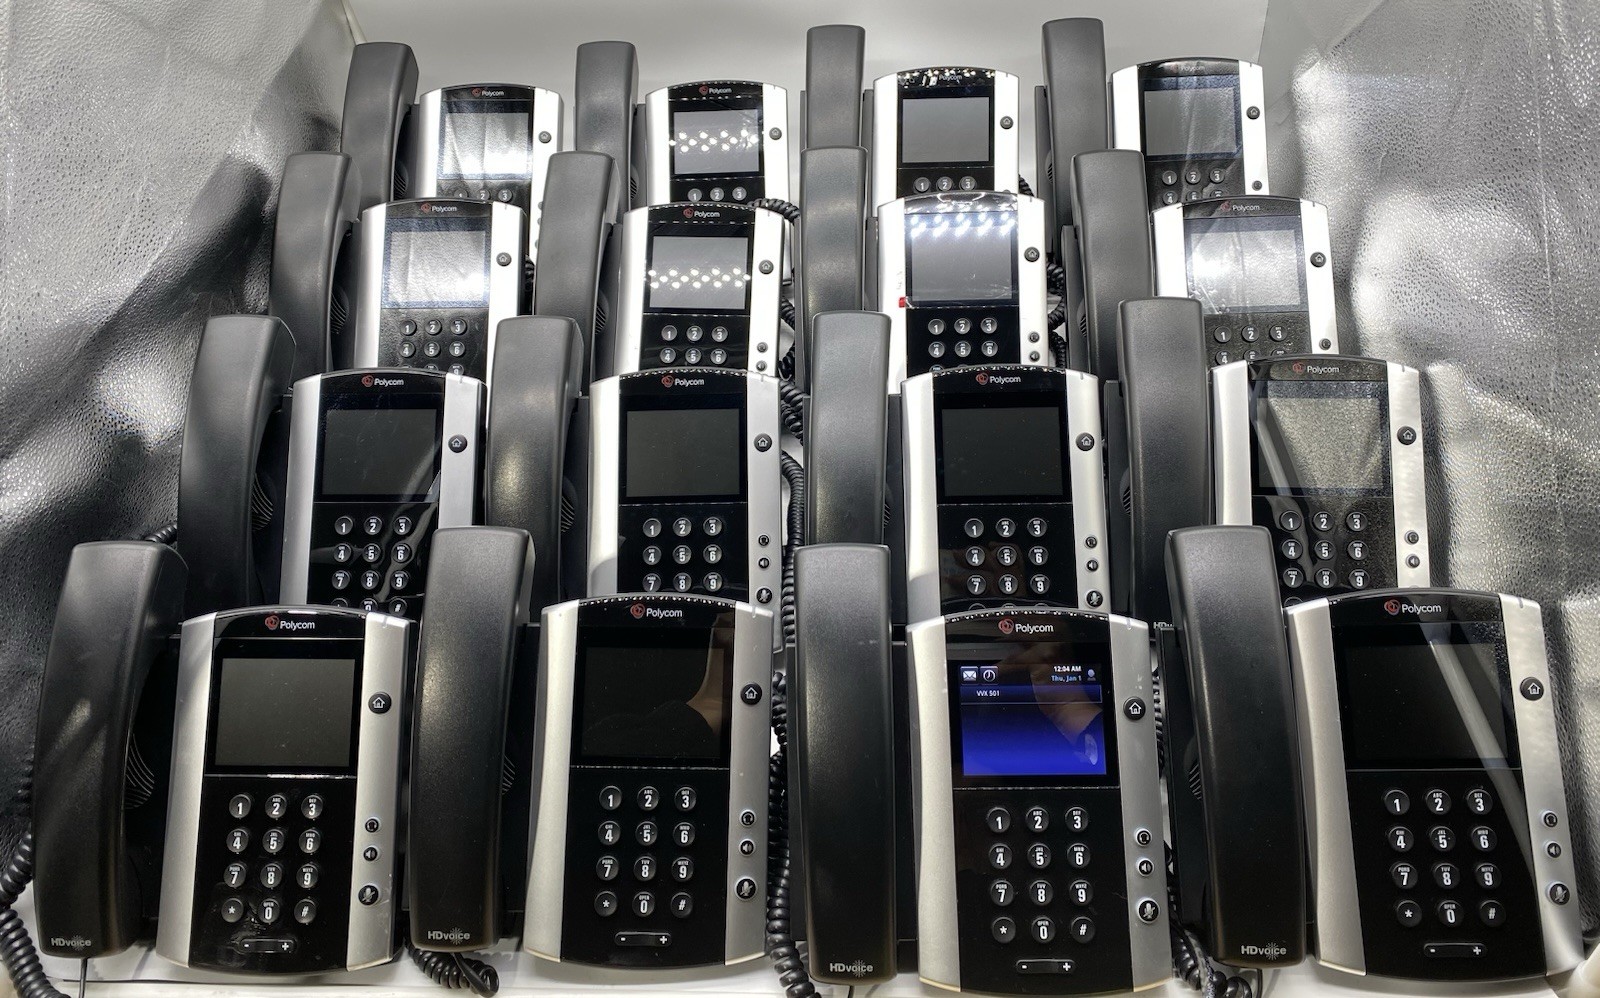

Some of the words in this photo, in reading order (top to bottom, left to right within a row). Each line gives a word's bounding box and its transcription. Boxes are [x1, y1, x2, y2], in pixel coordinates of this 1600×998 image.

[1232, 204, 1260, 212] Polycom
[694, 210, 720, 218] Polycom
[430, 324, 436, 332] 2
[455, 324, 460, 332] 3
[960, 324, 965, 332] 2
[986, 323, 992, 331] 3
[692, 330, 697, 339] 2
[717, 332, 722, 340] 3
[1248, 331, 1254, 340] 2
[1276, 330, 1282, 339] 3
[403, 347, 409, 355] 4
[429, 346, 434, 354] 5
[454, 346, 460, 354] 6
[933, 348, 940, 356] 4
[960, 347, 966, 355] 5
[987, 346, 993, 354] 6
[664, 354, 670, 362] 4
[691, 354, 696, 362] 5
[716, 354, 721, 362] 6
[1222, 355, 1228, 364] 4
[1307, 365, 1340, 374] Polycom
[374, 378, 404, 387] Polycom
[675, 378, 704, 387] Polycom
[990, 376, 1021, 384] Polycom
[370, 523, 376, 532] 2
[399, 523, 405, 532] 3
[1321, 518, 1327, 528] 2
[1354, 519, 1360, 529] 3
[679, 524, 686, 534] 2
[710, 524, 716, 533] 3
[1003, 525, 1009, 535] 2
[1034, 525, 1041, 535] 3
[338, 550, 345, 560] 4
[368, 550, 374, 560] 5
[398, 550, 404, 560] 6
[679, 552, 685, 562] 5
[710, 552, 716, 561] 6
[1288, 547, 1296, 557] 4
[1322, 547, 1328, 558] 5
[1355, 548, 1361, 558] 6
[648, 553, 655, 562] 4
[972, 554, 979, 564] 4
[1004, 553, 1011, 564] 5
[1036, 553, 1042, 563] 6
[337, 577, 343, 587] 7
[366, 577, 373, 587] 8
[396, 578, 402, 588] 9
[649, 580, 654, 590] 7
[679, 580, 685, 590] 8
[710, 579, 716, 589] 9
[1290, 575, 1296, 586] 7
[1323, 576, 1329, 586] 8
[1356, 576, 1363, 586] 9
[973, 582, 979, 592] 7
[1005, 581, 1012, 592] 8
[1037, 581, 1044, 592] 9
[646, 608, 682, 618] Polycom
[1402, 604, 1441, 614] Polycom
[280, 620, 315, 631] Polycom
[1015, 624, 1054, 634] Polycom
[608, 794, 613, 807] 1
[645, 794, 652, 807] 2
[682, 796, 689, 808] 3
[1394, 798, 1400, 812] 1
[1435, 798, 1443, 811] 2
[1475, 798, 1484, 811] 3
[238, 802, 242, 815] 1
[272, 802, 280, 815] 2
[308, 803, 316, 816] 3
[996, 816, 1002, 830] 1
[1034, 816, 1042, 828] 2
[1074, 816, 1081, 828] 3
[605, 830, 613, 842] 4
[643, 830, 650, 842] 5
[681, 830, 688, 843] 6
[233, 837, 241, 850] 4
[270, 837, 277, 850] 5
[306, 838, 314, 850] 6
[1397, 836, 1406, 848] 4
[1439, 836, 1447, 848] 5
[1480, 836, 1489, 848] 6
[996, 853, 1005, 866] 4
[1036, 852, 1044, 866] 5
[1076, 852, 1083, 865] 6
[604, 865, 611, 877] 7
[642, 865, 649, 877] 8
[679, 866, 687, 878] 9
[231, 872, 238, 884] 7
[267, 872, 275, 884] 8
[304, 873, 311, 885] 9
[1400, 872, 1408, 885] 7
[1443, 872, 1451, 885] 8
[1484, 872, 1493, 886] 9
[998, 889, 1005, 902] 7
[1038, 889, 1045, 902] 8
[1078, 889, 1086, 902] 9
[640, 900, 648, 913] 0
[265, 907, 272, 920] 0
[1446, 909, 1455, 923] 0
[1040, 926, 1048, 939] 0
